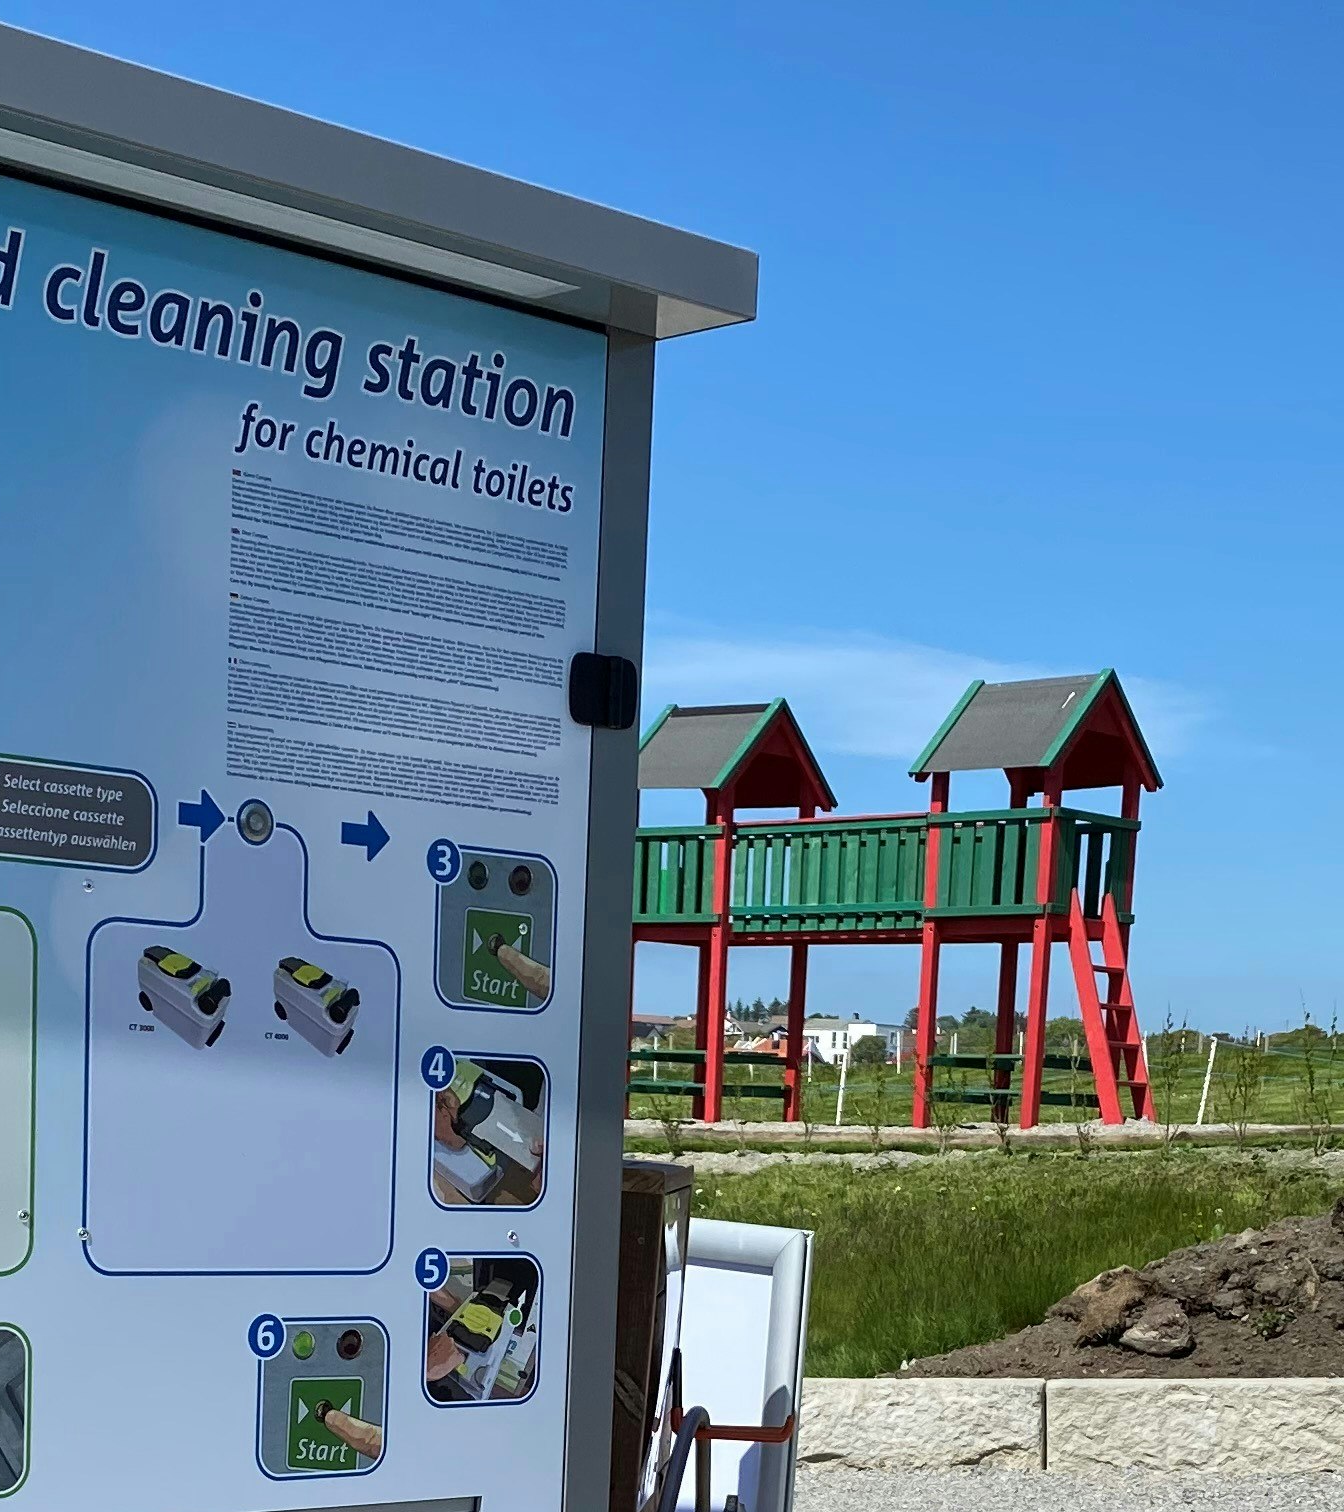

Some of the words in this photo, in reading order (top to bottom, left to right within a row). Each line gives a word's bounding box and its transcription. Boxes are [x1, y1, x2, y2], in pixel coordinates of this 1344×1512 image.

[45, 249, 343, 399] cleaning
[364, 337, 575, 438] station
[235, 403, 295, 452] for
[306, 422, 462, 488] chemical
[473, 456, 573, 512] toilets
[4, 774, 40, 791] Select
[44, 780, 92, 798] cassette
[96, 787, 123, 803] type
[1, 799, 70, 819] Seleccione
[73, 809, 124, 826] cassette
[71, 832, 136, 851] auswählen
[436, 846, 452, 876] 3
[471, 969, 519, 999] Start
[428, 1053, 446, 1082] 4
[423, 1254, 439, 1283] 5
[257, 1321, 275, 1350] 6
[296, 1439, 348, 1463] Start
